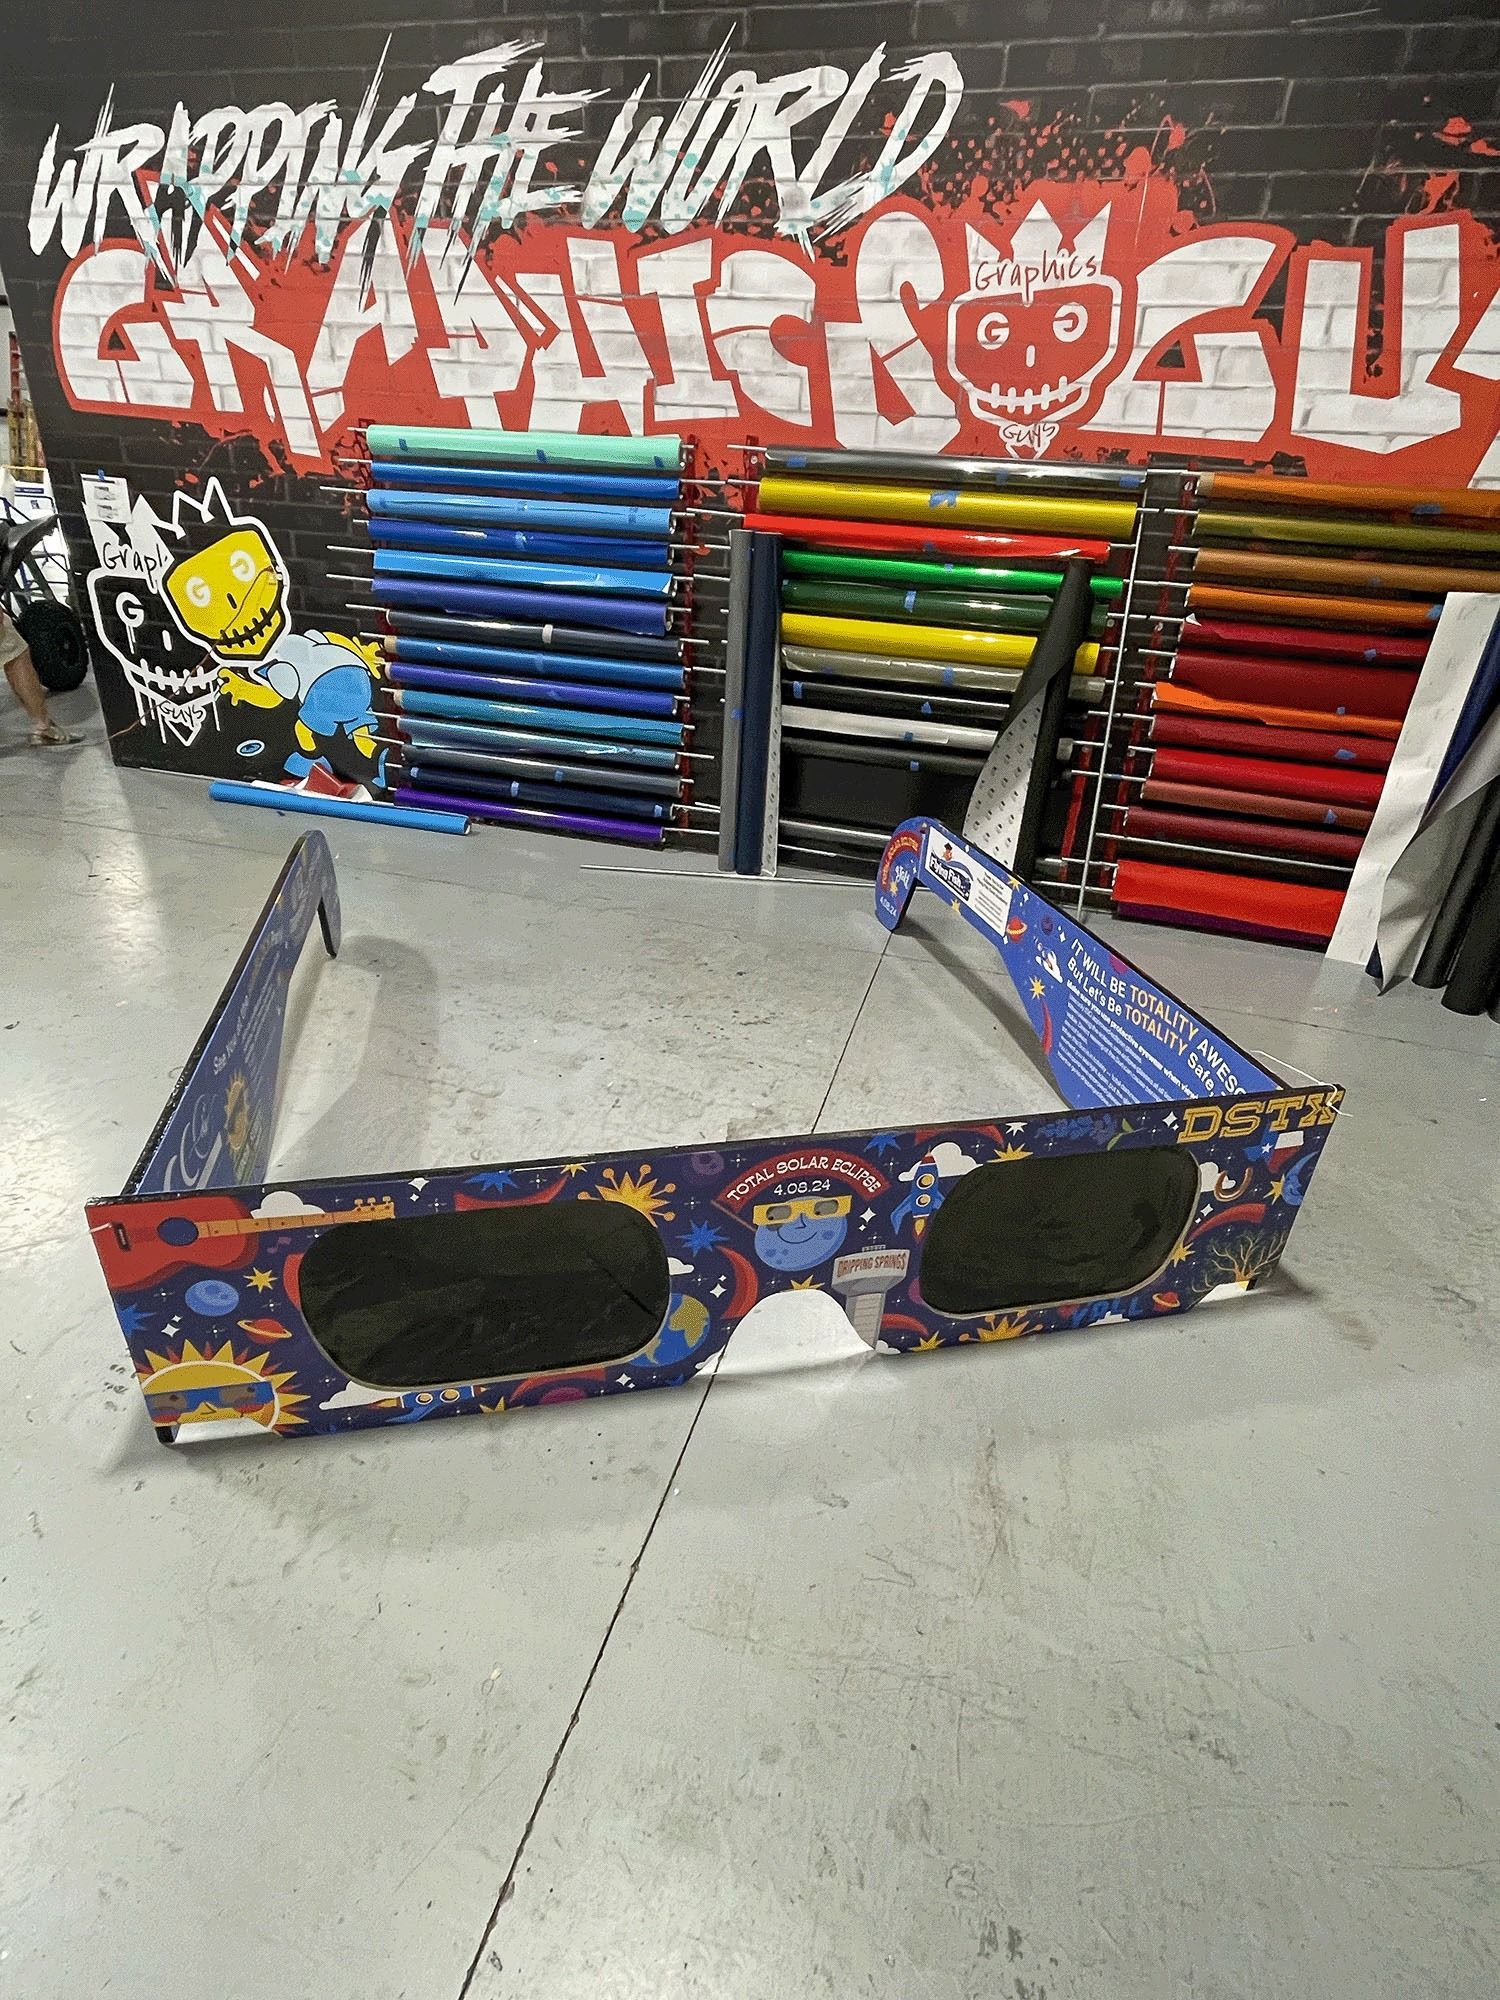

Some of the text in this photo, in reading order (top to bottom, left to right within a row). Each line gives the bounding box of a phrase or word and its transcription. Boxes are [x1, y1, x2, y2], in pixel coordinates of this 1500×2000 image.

[27, 22, 964, 288] WRAPPING THE WORLD
[975, 250, 1097, 303] Graphics
[1067, 957, 1084, 983] But
[1083, 977, 1107, 1006] Let's
[1107, 998, 1122, 1017] Be
[1124, 1003, 1188, 1057] TOTALITY
[1071, 938, 1084, 957] IT
[1082, 948, 1107, 988] WILL
[1109, 975, 1127, 999] BE
[1130, 984, 1199, 1042] TOTALITY
[1176, 1090, 1345, 1144] DSTX
[726, 1156, 882, 1201] TOTAL SOLAR ECLIPSE
[773, 1179, 831, 1196] 4.08.24
[836, 1252, 908, 1278] DRIPPING SPRINGS
